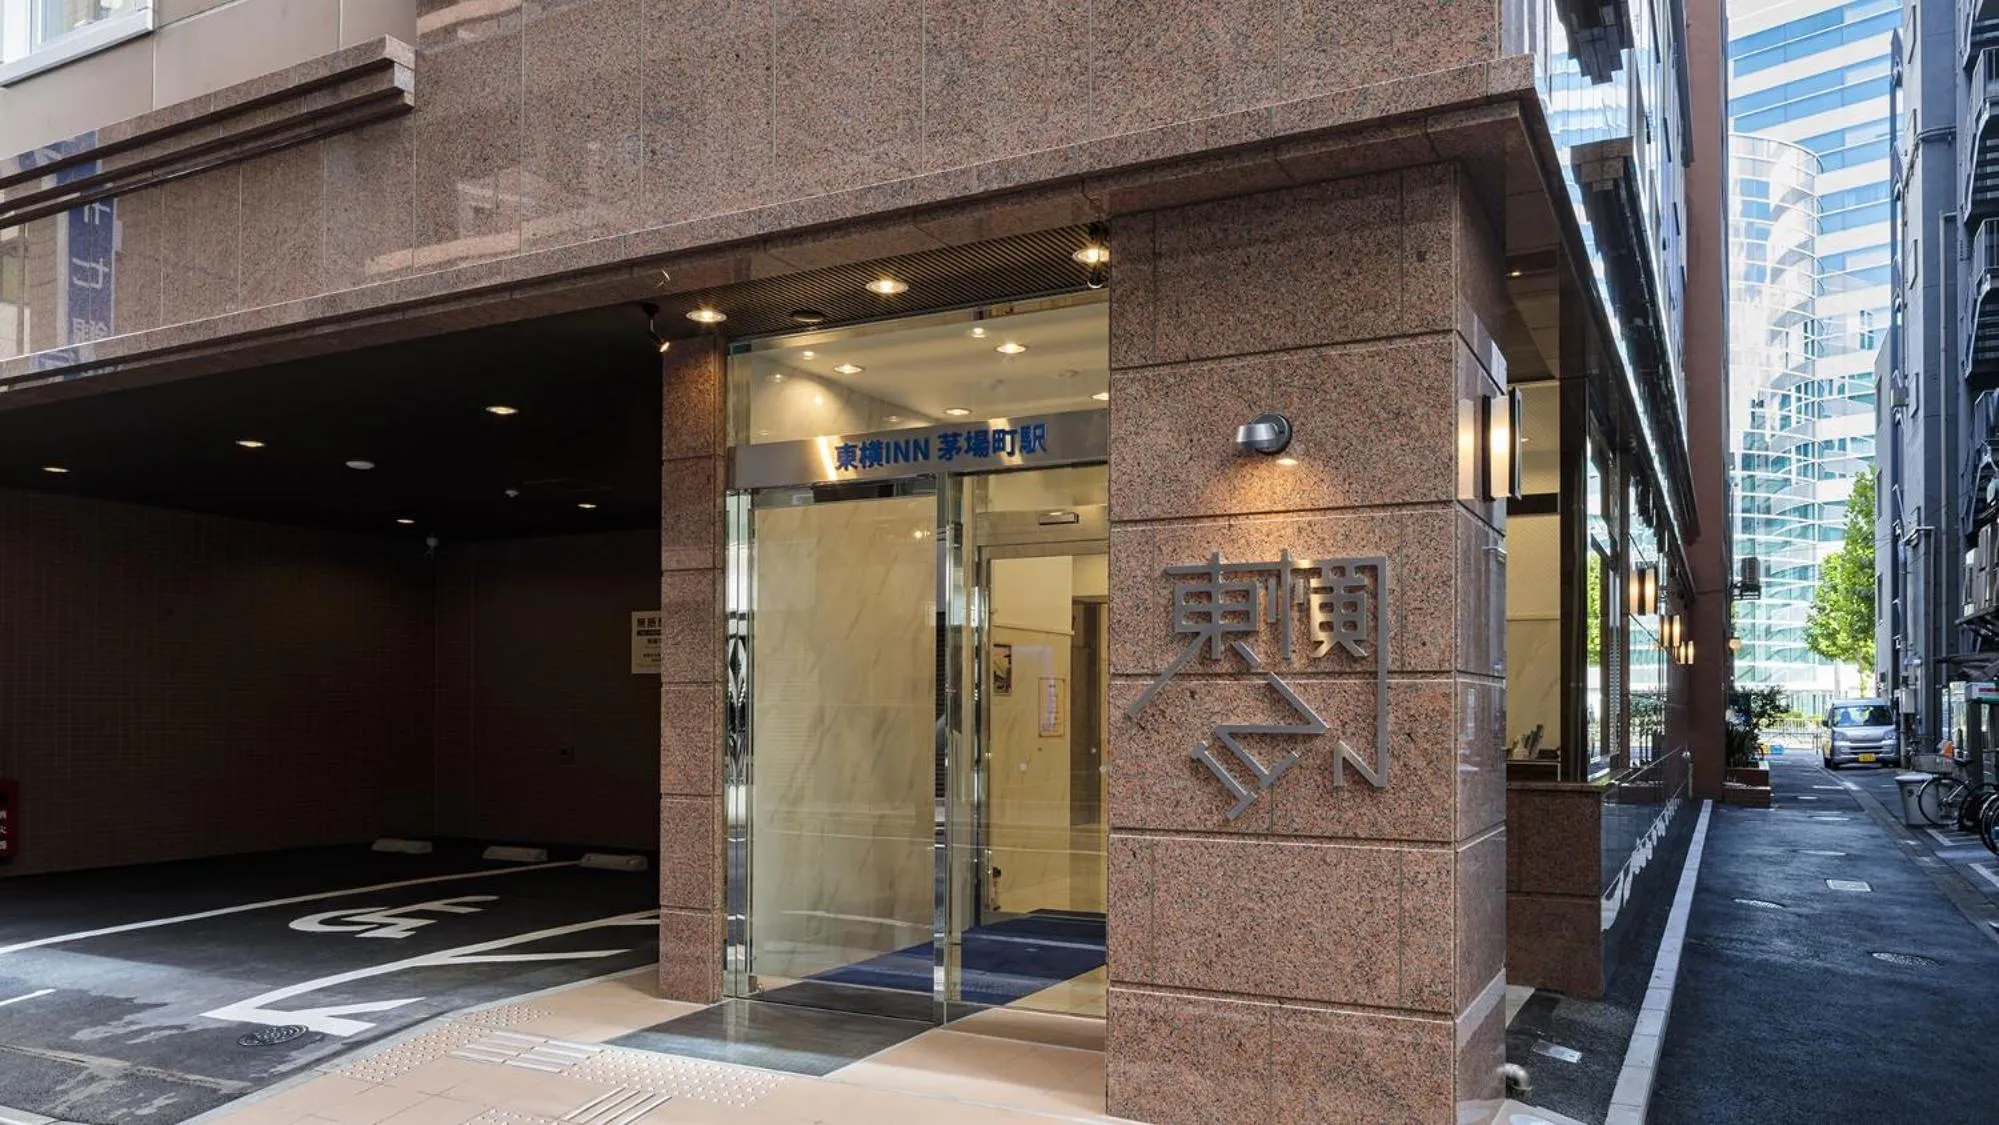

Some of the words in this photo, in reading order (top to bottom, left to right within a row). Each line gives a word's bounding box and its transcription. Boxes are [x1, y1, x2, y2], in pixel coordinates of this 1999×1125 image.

[835, 438, 930, 471] 東横INN
[938, 424, 1047, 461] 茅場町駅
